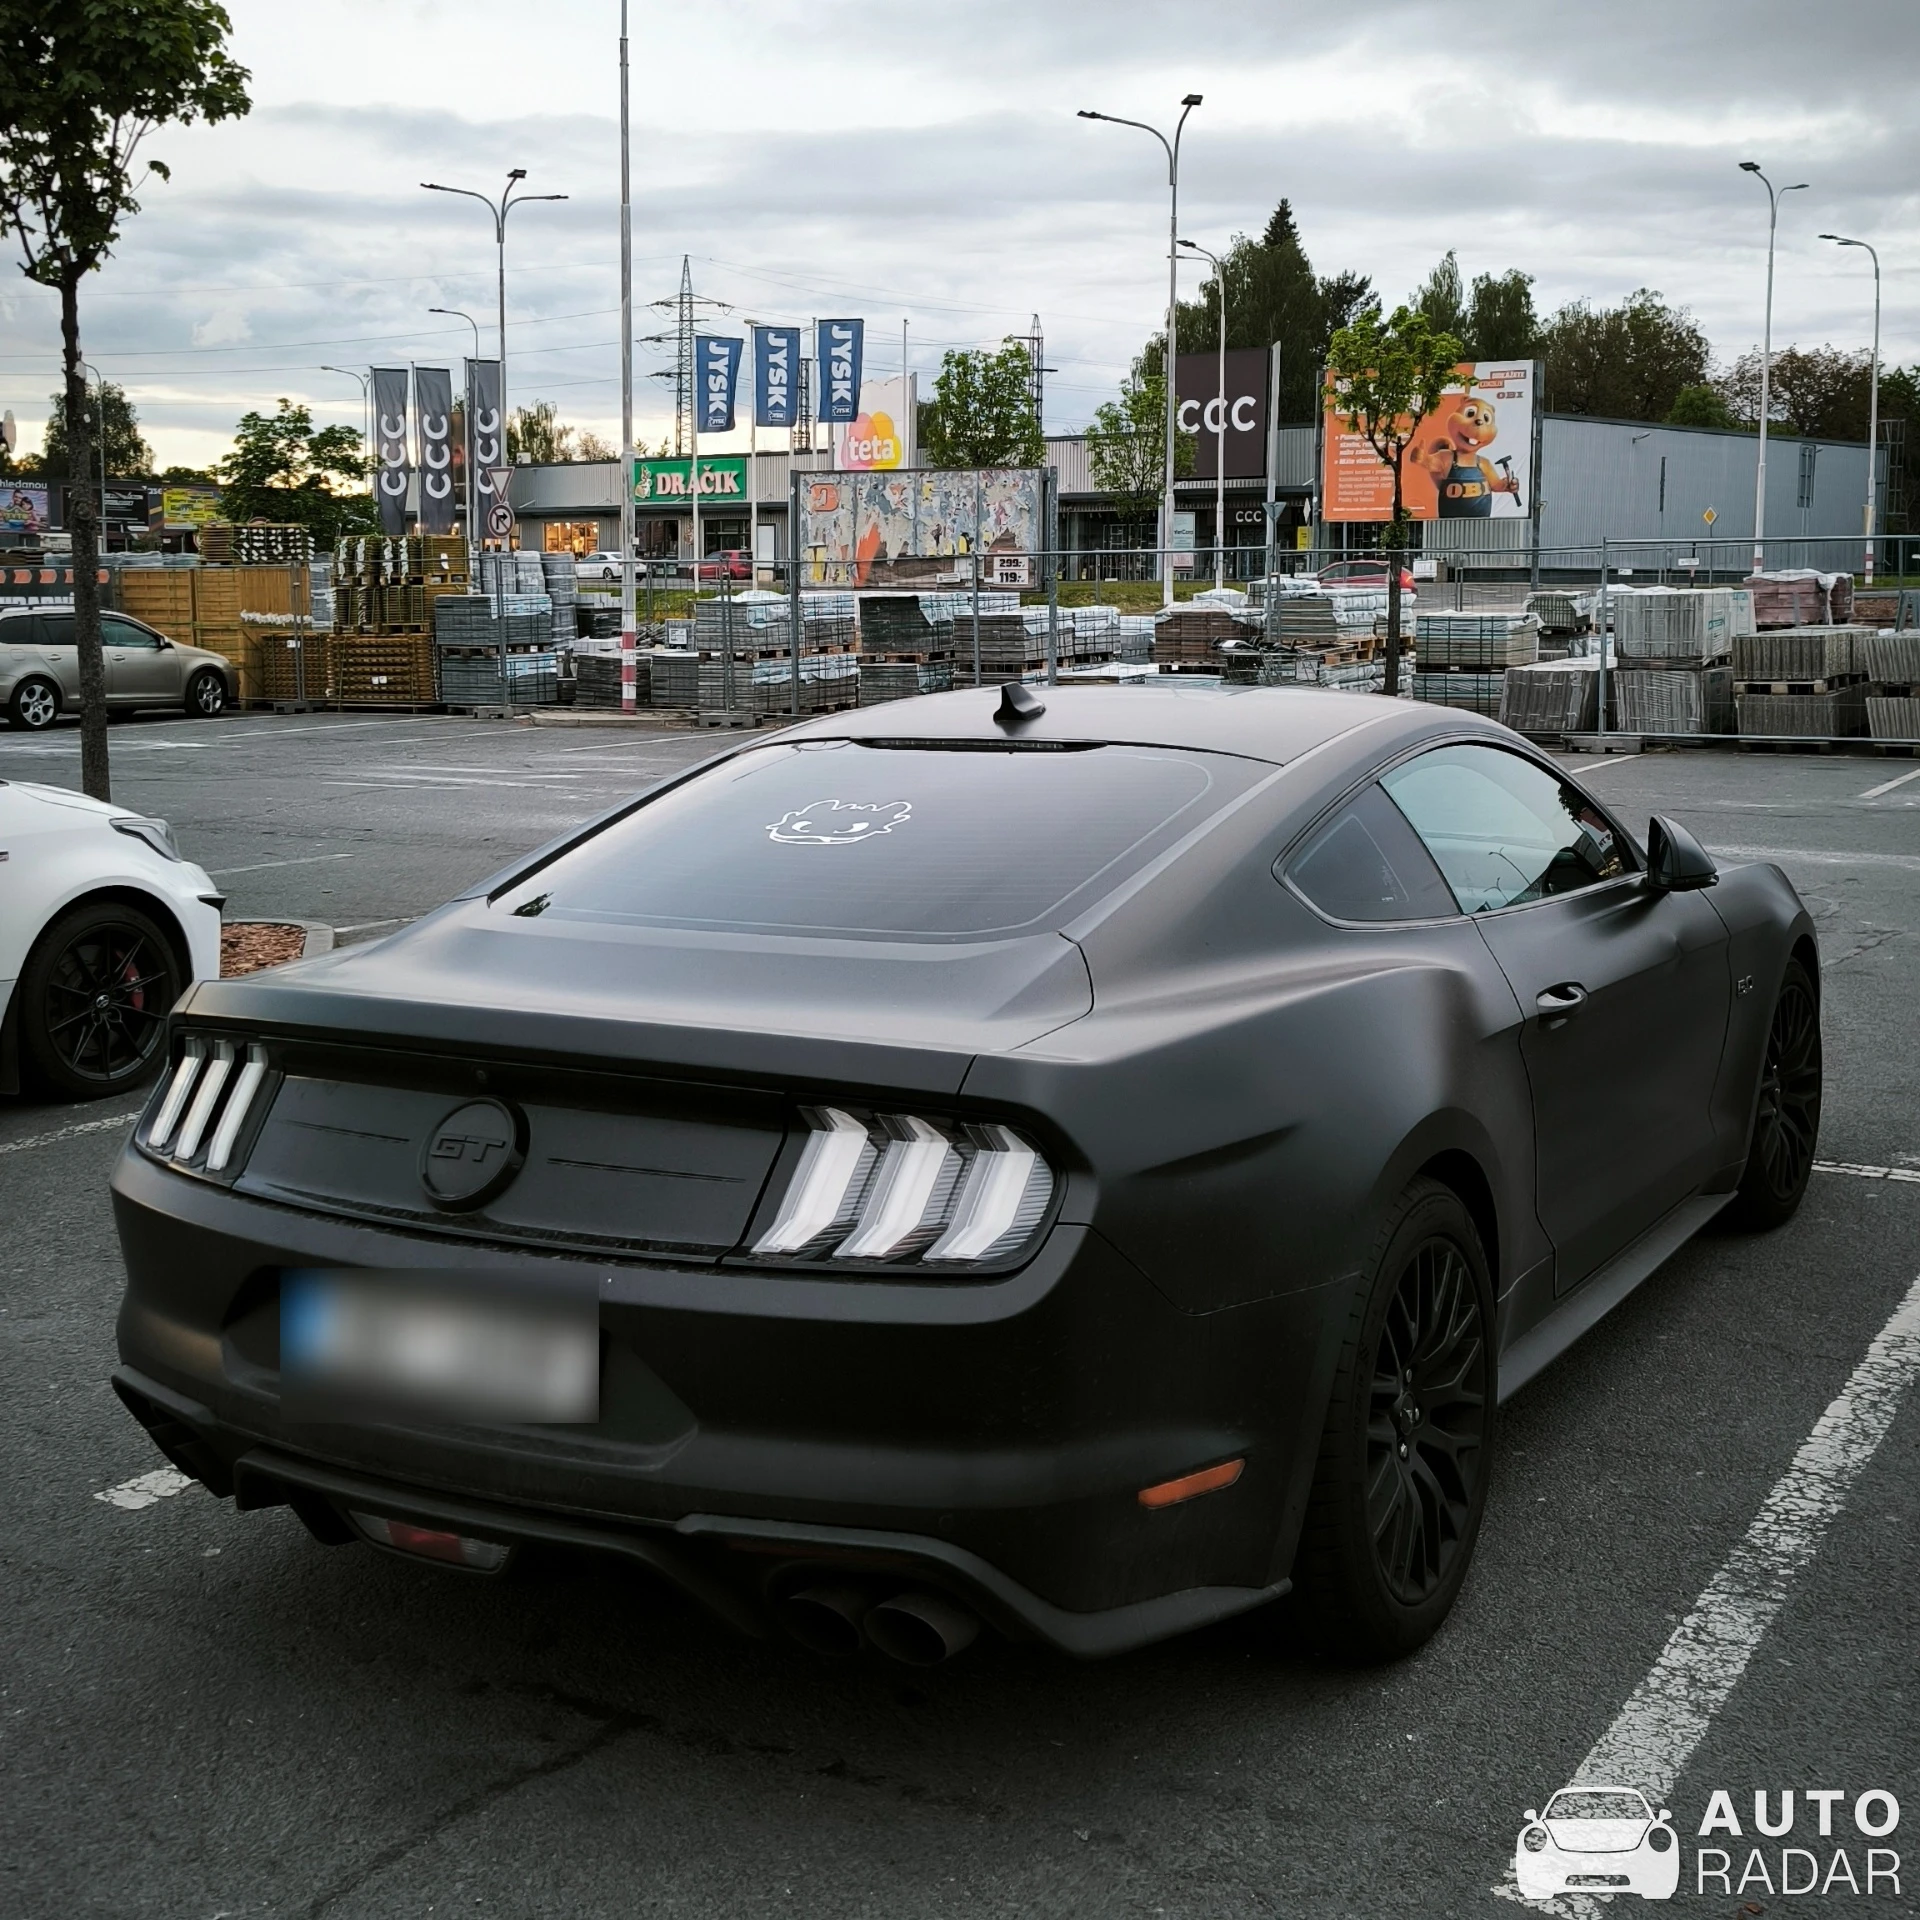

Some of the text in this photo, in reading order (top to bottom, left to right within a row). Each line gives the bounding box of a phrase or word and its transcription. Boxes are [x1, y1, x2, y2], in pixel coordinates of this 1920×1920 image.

[708, 341, 730, 413] JYSK
[767, 332, 788, 408] JYSK
[831, 324, 853, 403] JYSK
[1496, 391, 1524, 399] OBI
[1177, 395, 1257, 434] CCC
[848, 436, 895, 462] teta
[656, 464, 741, 495] DRÁČIK
[1235, 510, 1262, 523] CCC
[430, 1133, 507, 1163] GT
